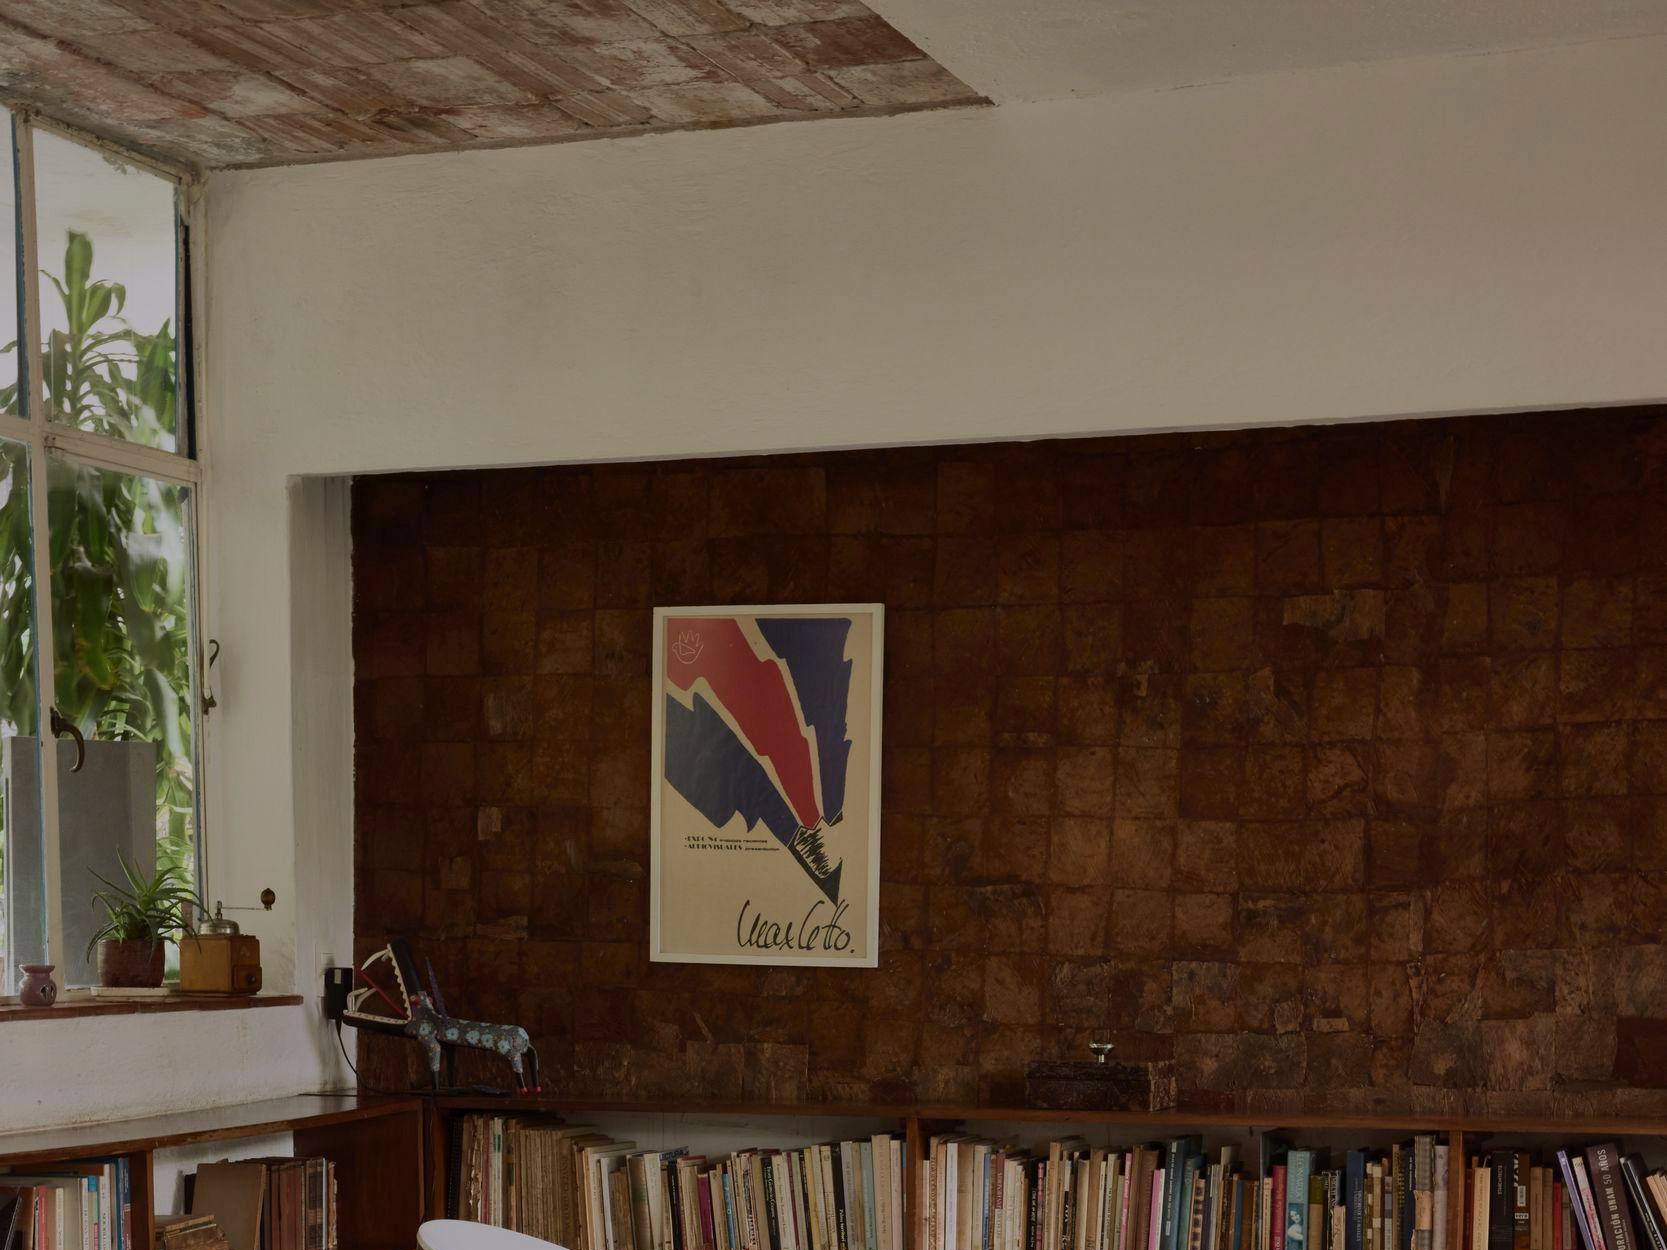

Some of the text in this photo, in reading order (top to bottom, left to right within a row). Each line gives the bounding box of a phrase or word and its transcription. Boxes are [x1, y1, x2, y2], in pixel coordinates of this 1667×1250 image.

[1595, 1148, 1609, 1172] AÑOS
[1601, 1173, 1612, 1185] 50
[1604, 1186, 1617, 1211] UNAM
